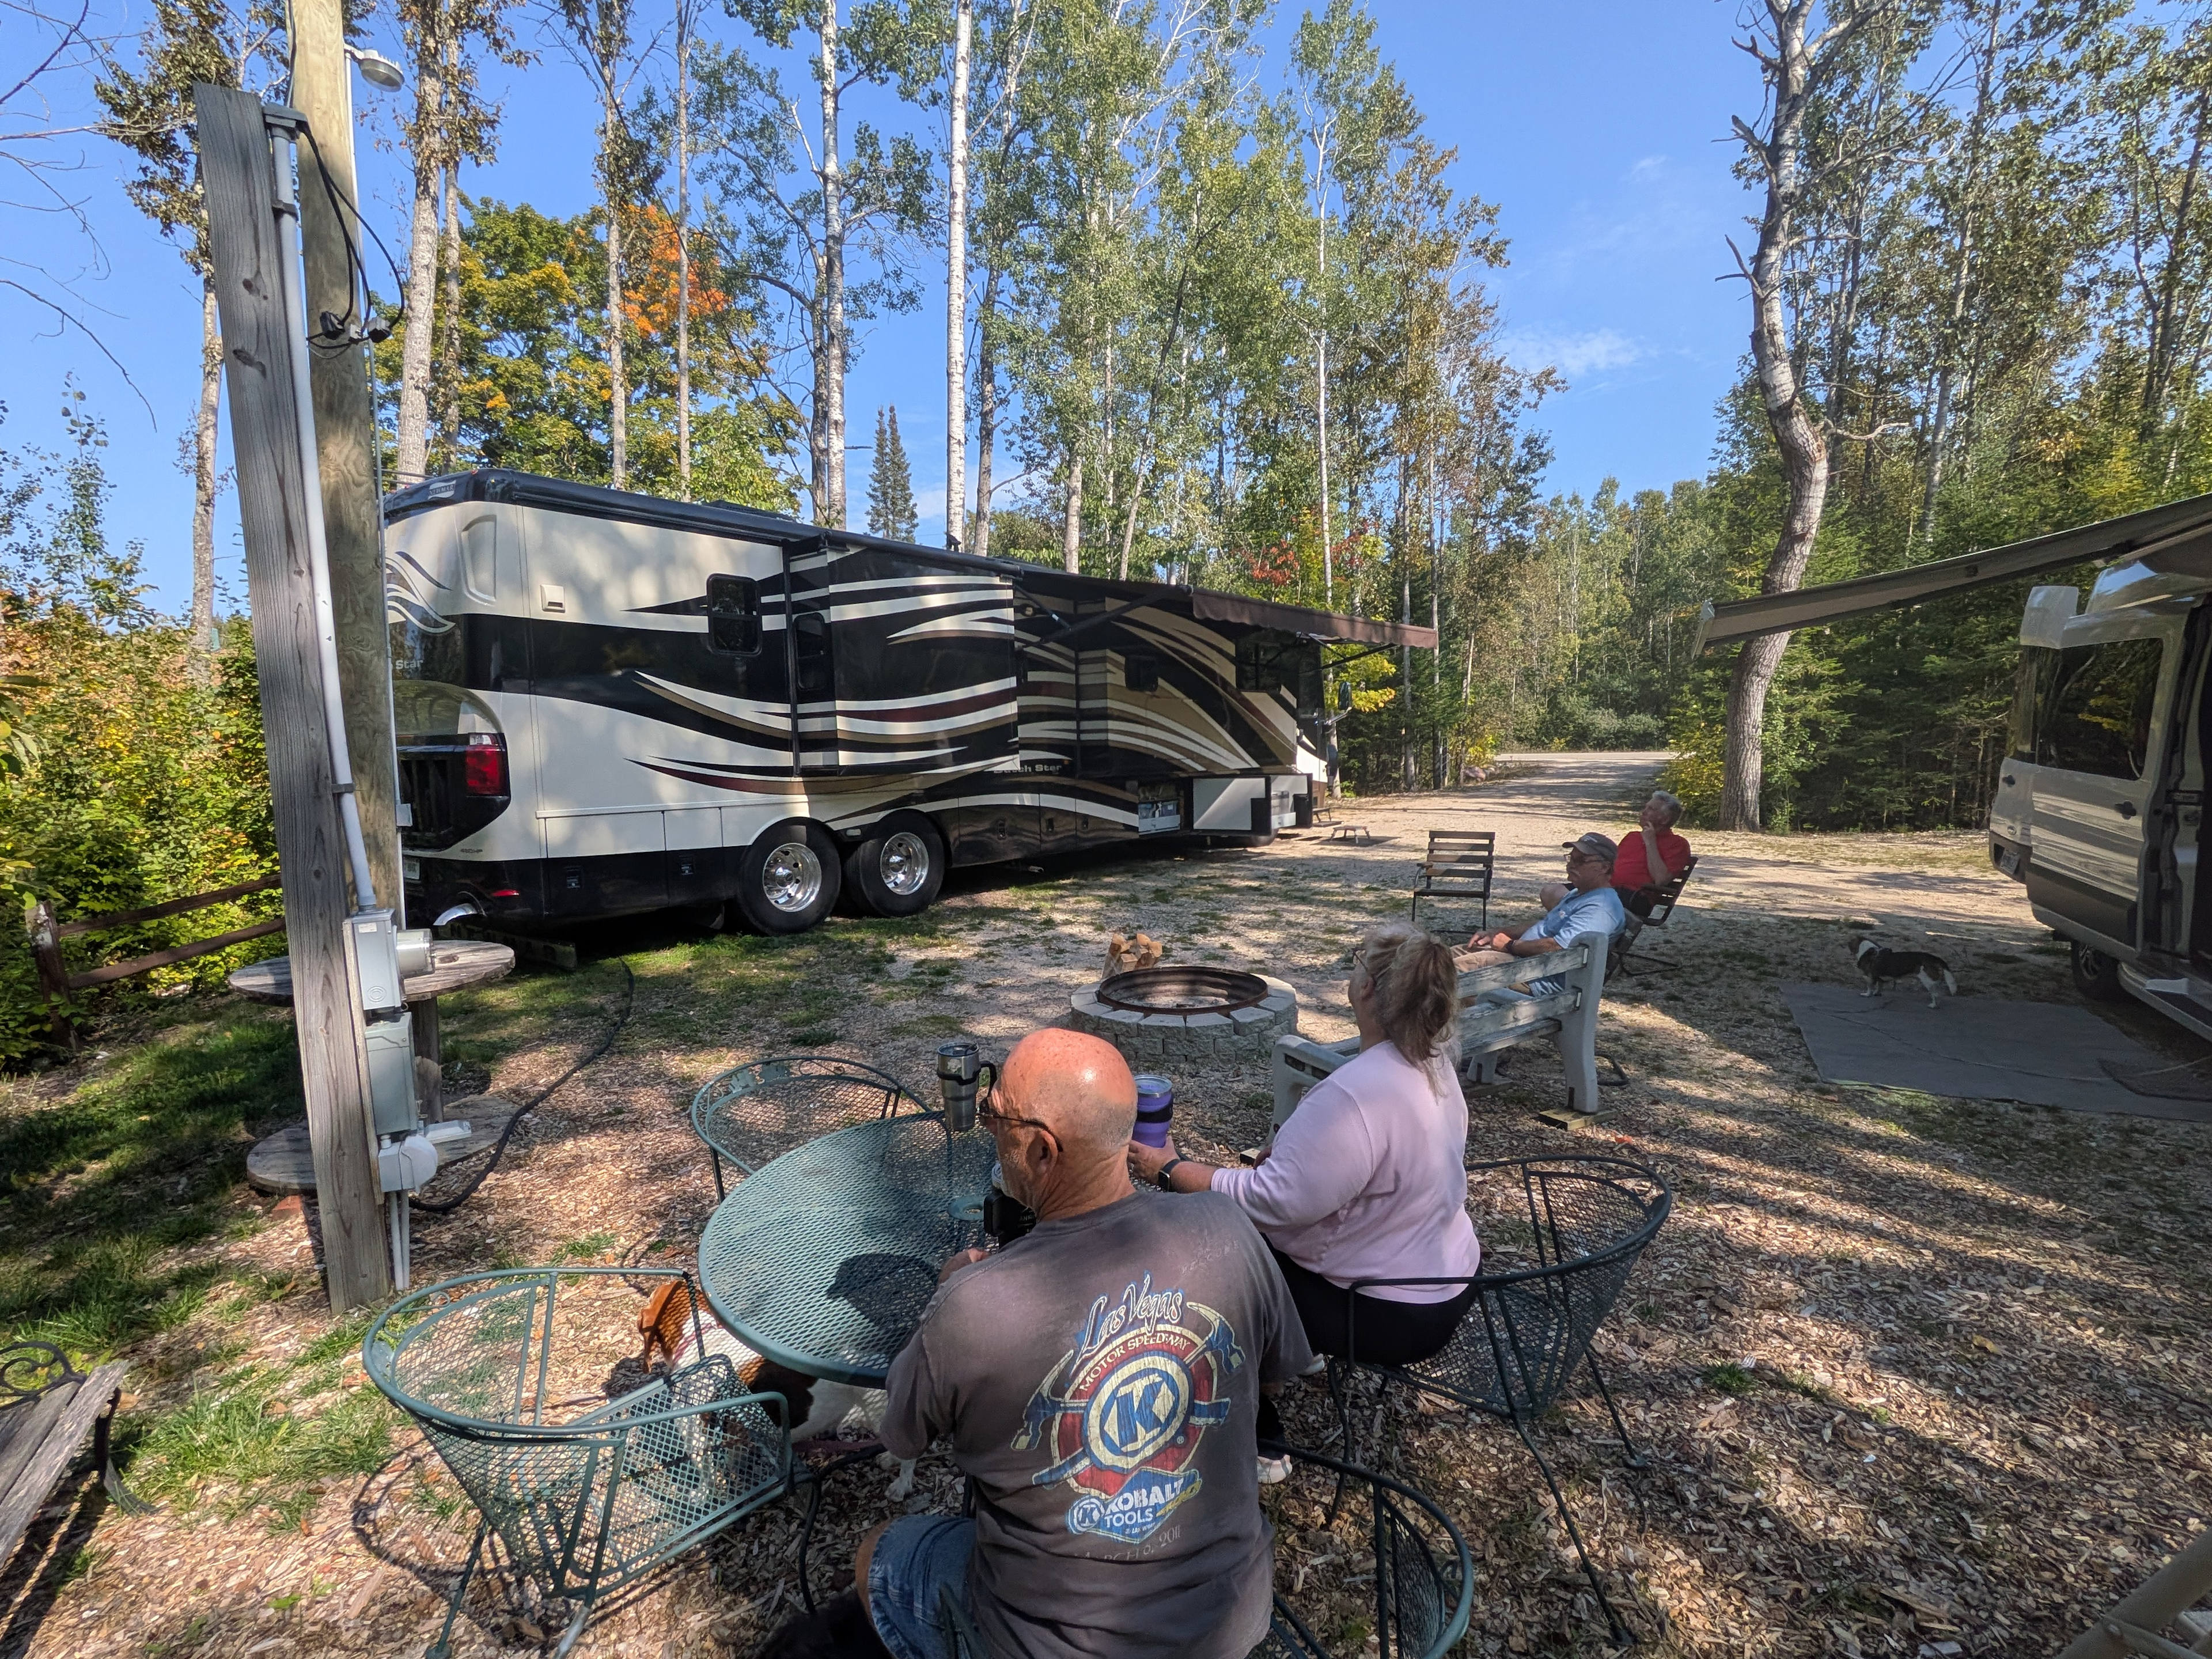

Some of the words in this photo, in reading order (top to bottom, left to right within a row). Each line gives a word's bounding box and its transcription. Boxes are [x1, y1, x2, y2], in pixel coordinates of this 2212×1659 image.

[395, 660, 424, 670] Star
[1035, 764, 1062, 772] Star
[1070, 1296, 1126, 1377] Las
[1123, 1274, 1183, 1336] Vegas
[1079, 1345, 1126, 1391] MOTOR
[1127, 1332, 1191, 1351] SPEEDWAY
[1105, 1478, 1184, 1516] KOBALT
[1104, 1508, 1154, 1528] TOOLS
[1159, 1525, 1181, 1548] 2011
